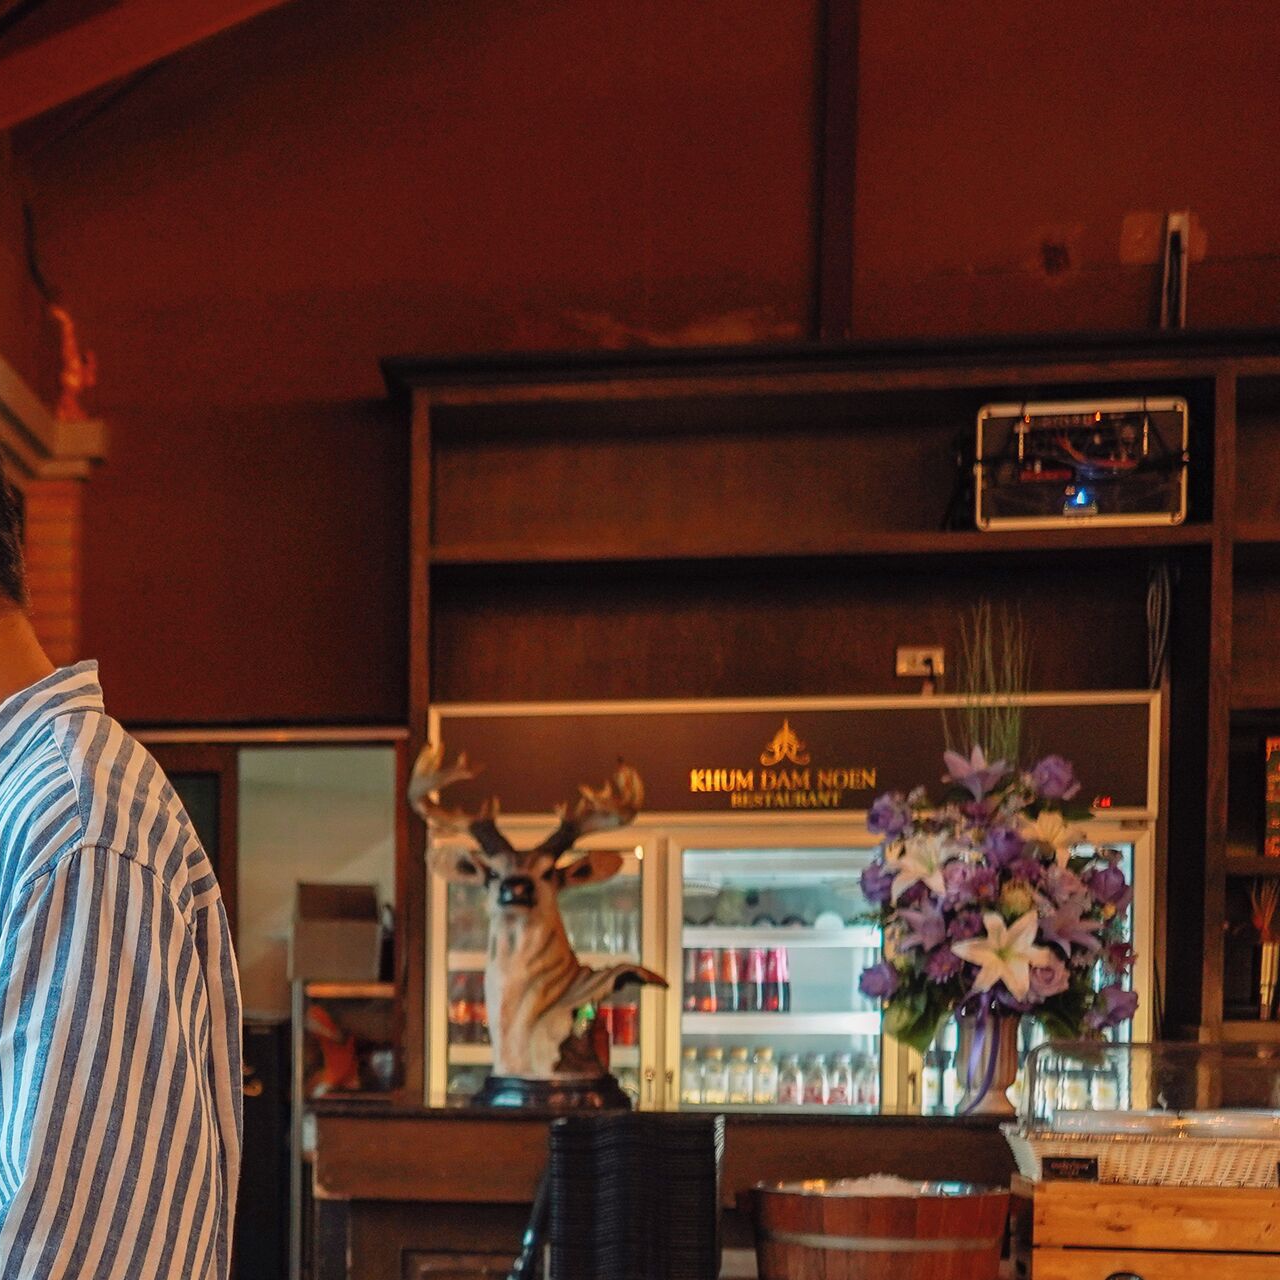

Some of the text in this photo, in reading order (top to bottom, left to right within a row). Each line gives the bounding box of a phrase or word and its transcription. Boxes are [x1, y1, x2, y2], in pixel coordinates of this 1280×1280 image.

[690, 767, 877, 792] KHUM DAM NOEN
[731, 791, 840, 809] RESTAURANT
